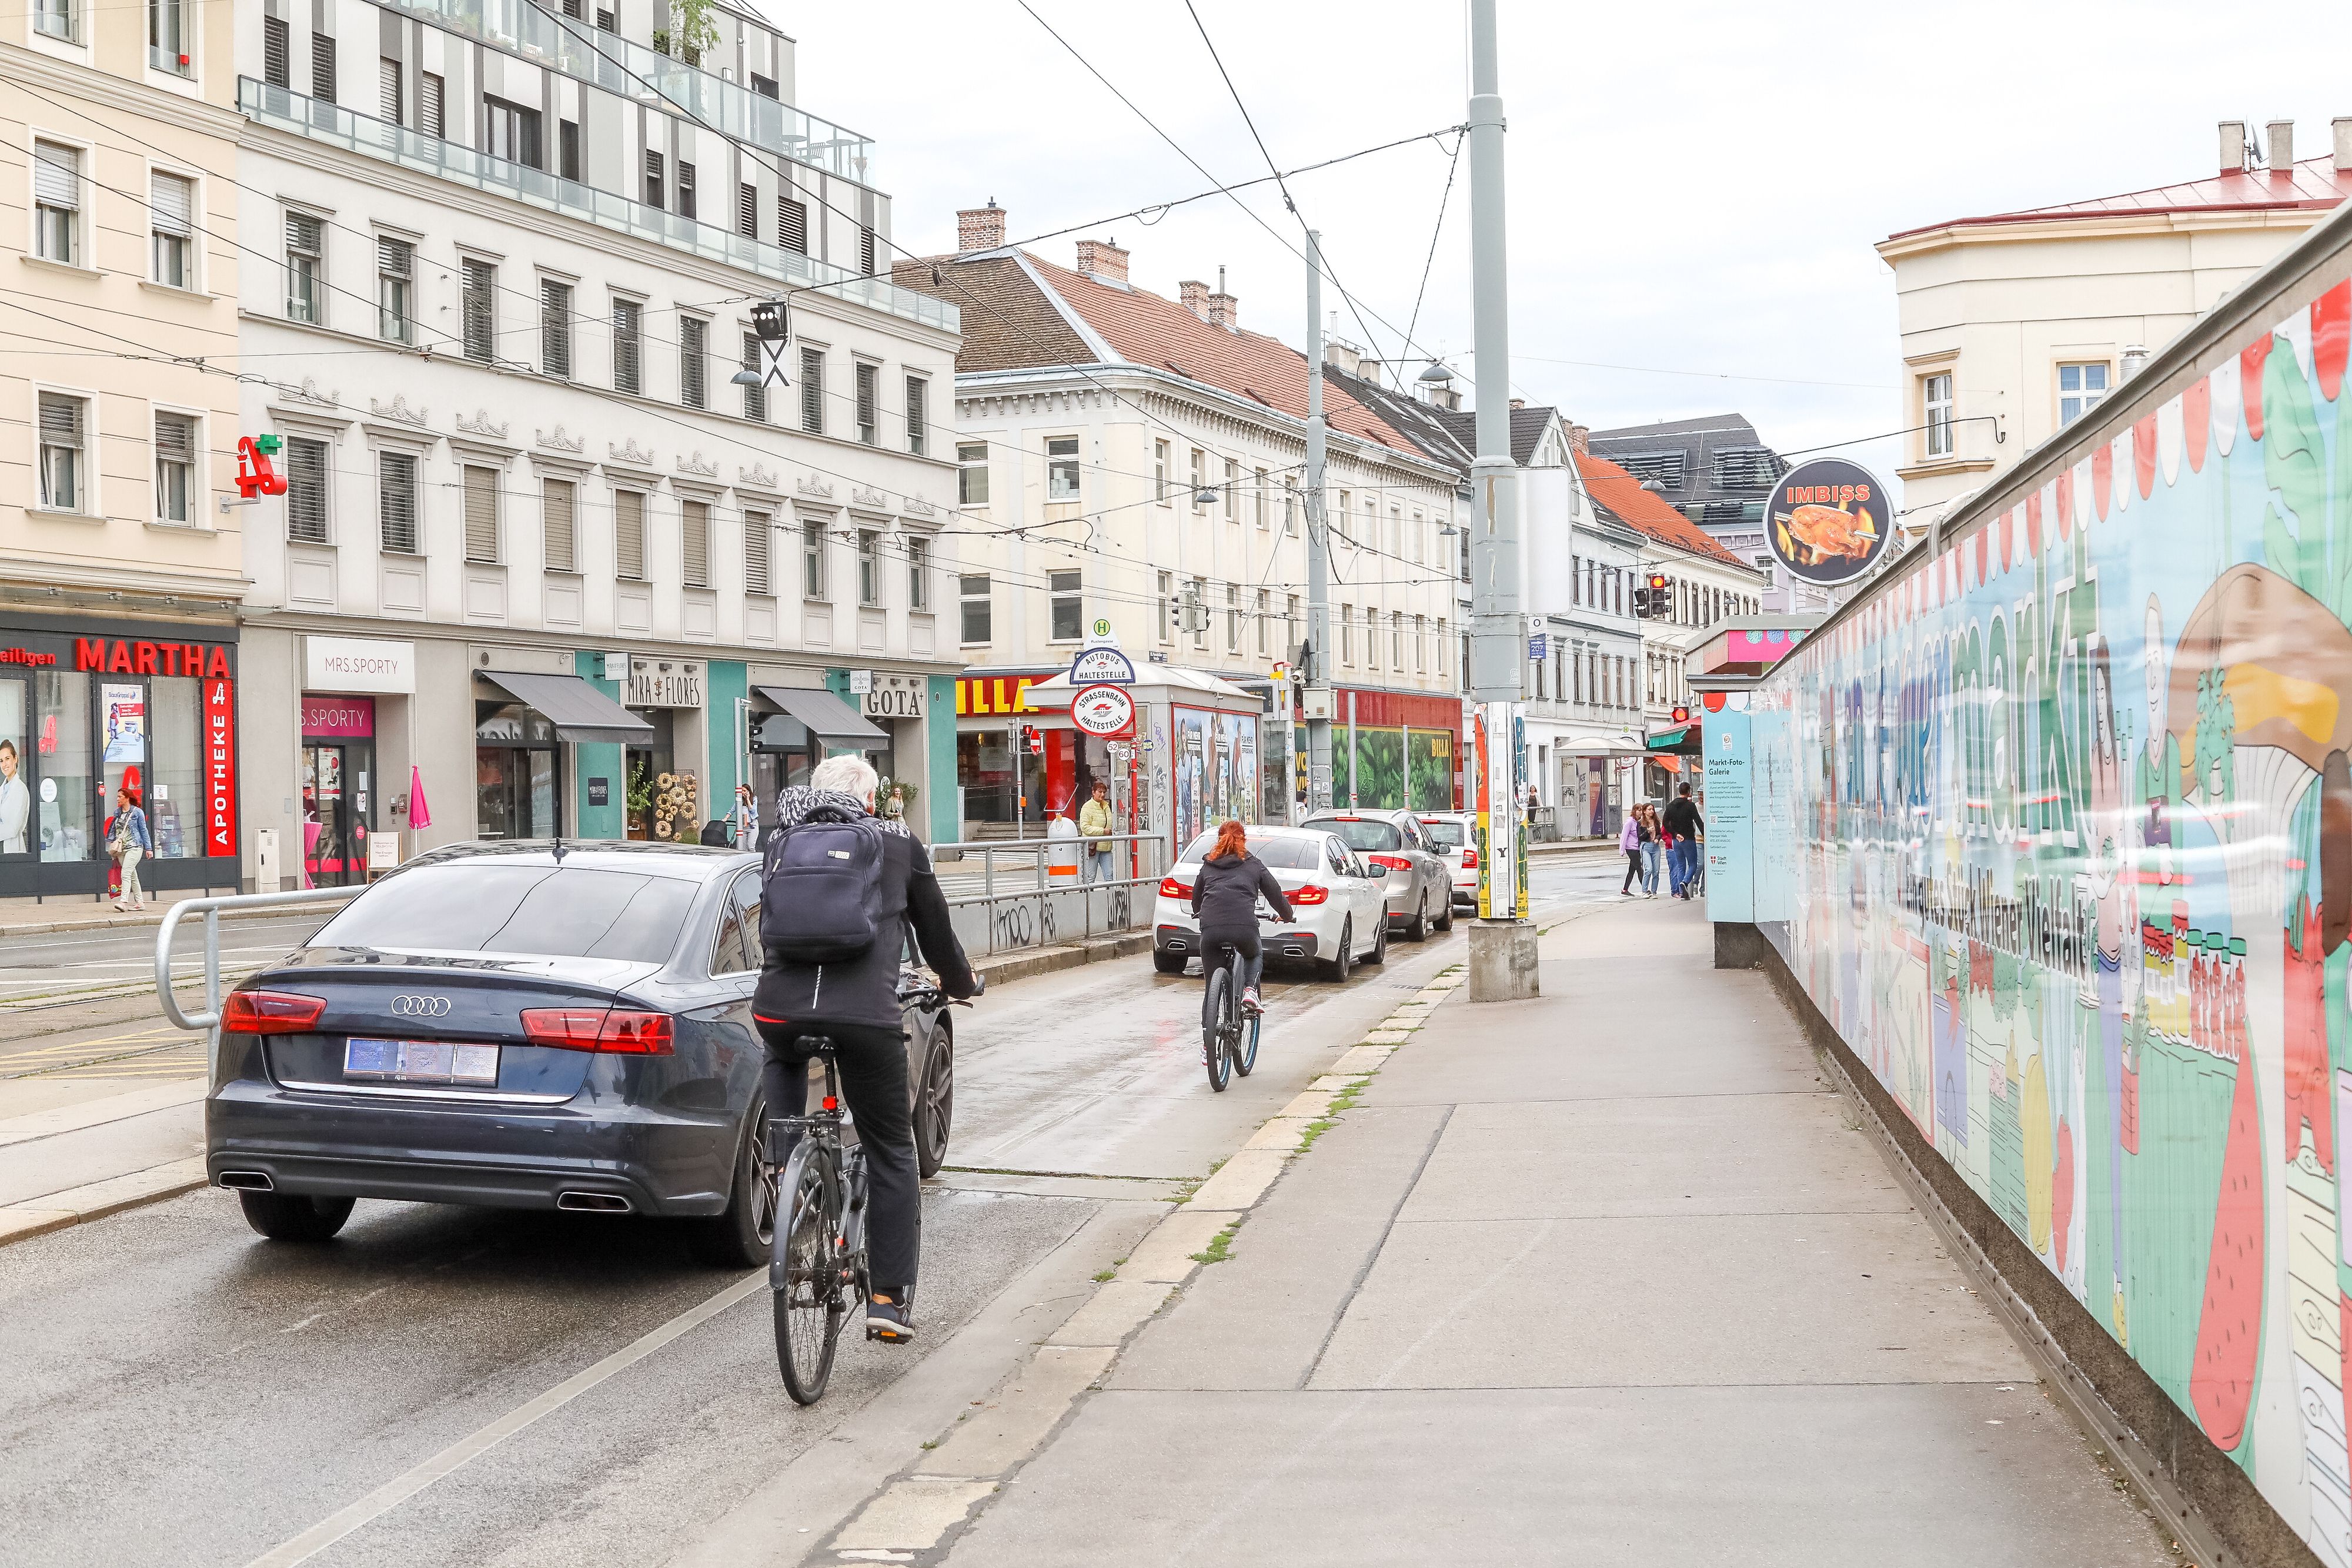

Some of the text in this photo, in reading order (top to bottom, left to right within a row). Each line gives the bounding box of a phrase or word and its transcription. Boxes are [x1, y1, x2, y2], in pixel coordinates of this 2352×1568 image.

[1787, 484, 1870, 504] IMBISS
[0, 637, 230, 678] eiligen MARTHA
[325, 657, 398, 675] MRS.SPORTY
[1085, 653, 1120, 665] AUTOBUS
[1079, 671, 1126, 679] HALTESTELLE
[628, 675, 700, 706] MIRA FLORES
[1078, 691, 1127, 708] STRASSENBAHN
[1081, 715, 1124, 730] HALTESTELLE
[1431, 738, 1449, 757] BILLA
[213, 714, 228, 845] APOTHEKE
[1918, 864, 1945, 940] gutes
[1946, 860, 1977, 939] Stück
[1978, 864, 2023, 959] Wiener
[2024, 872, 2090, 983] Vielfalt
